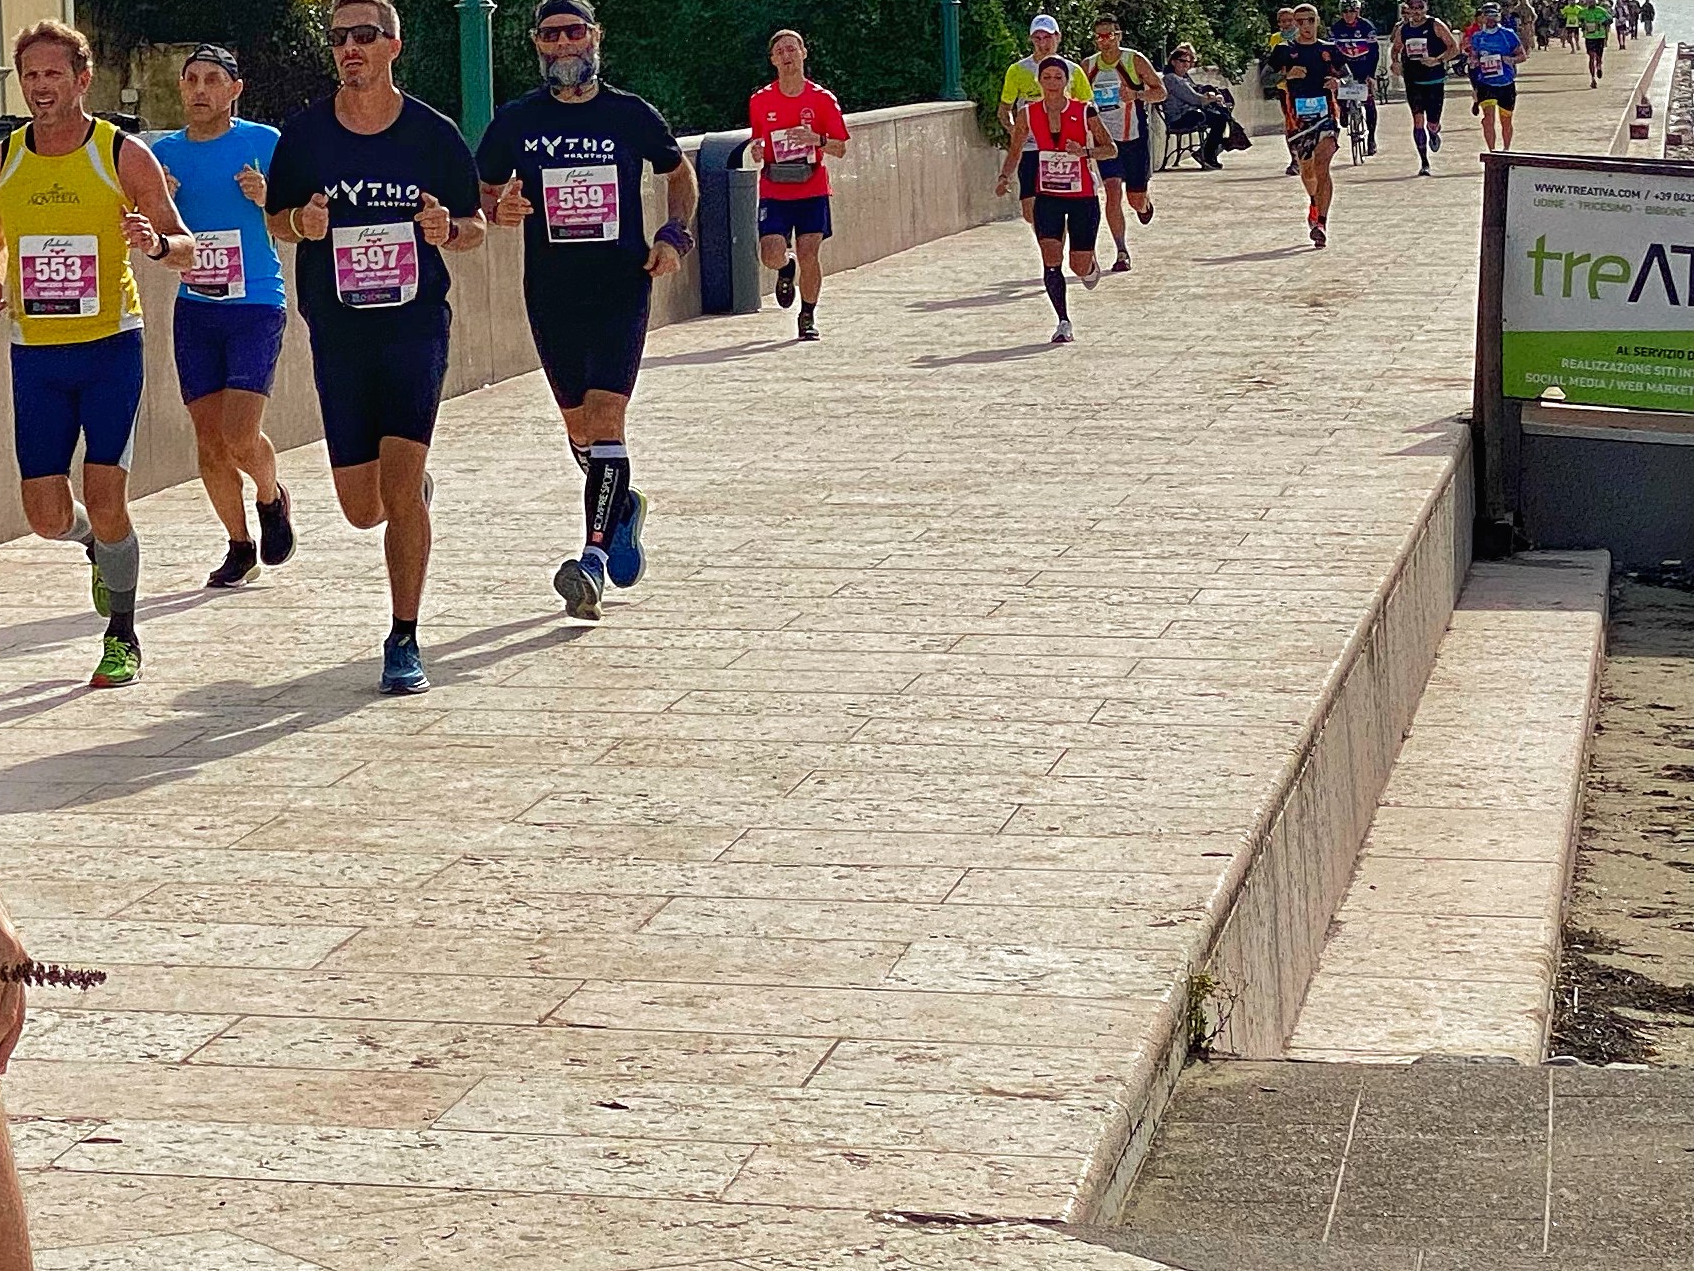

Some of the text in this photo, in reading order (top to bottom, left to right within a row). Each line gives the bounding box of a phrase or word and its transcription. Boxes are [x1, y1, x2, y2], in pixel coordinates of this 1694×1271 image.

[525, 136, 615, 157] MYTHO
[324, 179, 420, 206] MYTHO
[558, 186, 604, 209] 559
[1534, 183, 1641, 199] WWW.TREATIVA.COM
[34, 256, 82, 281] 553
[350, 245, 400, 272] 597
[1616, 346, 1629, 356] AL
[1634, 346, 1685, 360] SERVIZIO
[1561, 358, 1651, 375] REALIZZAZIONE
[1525, 373, 1566, 386] SOCIAL
[1569, 376, 1606, 388] MEDIA
[1617, 381, 1644, 392] WEB
